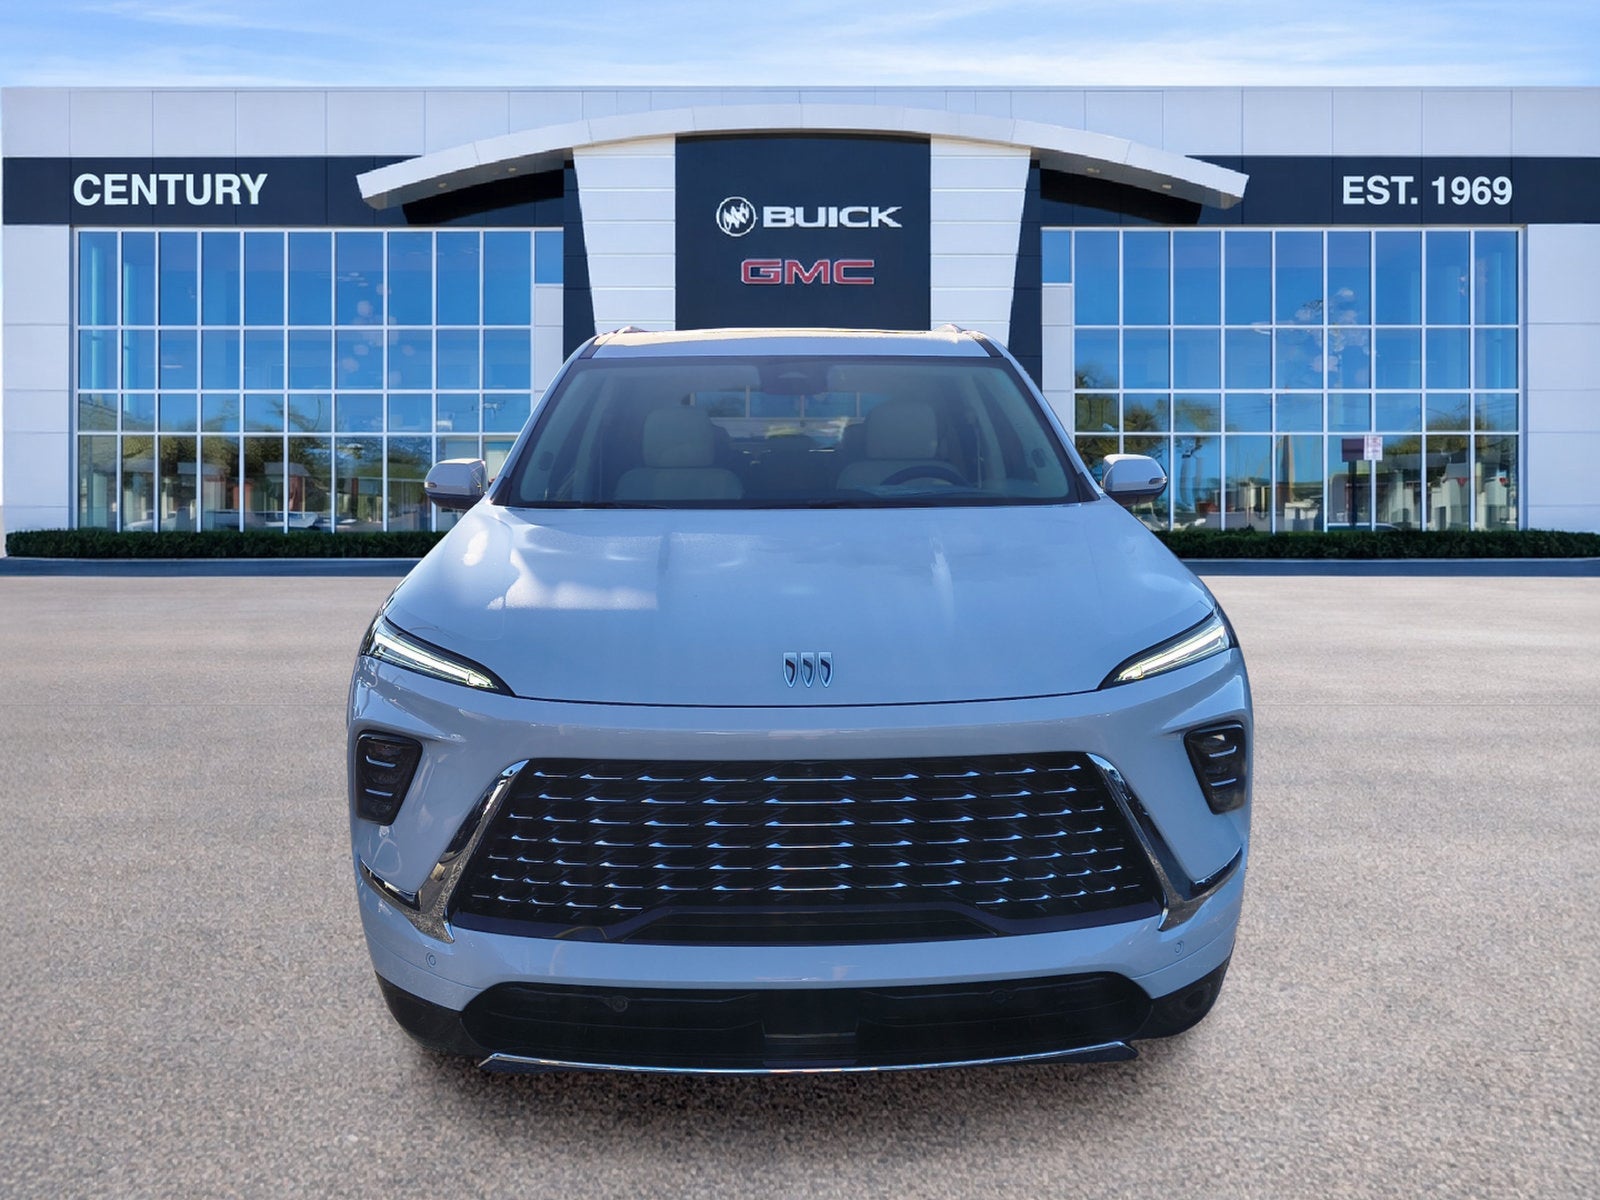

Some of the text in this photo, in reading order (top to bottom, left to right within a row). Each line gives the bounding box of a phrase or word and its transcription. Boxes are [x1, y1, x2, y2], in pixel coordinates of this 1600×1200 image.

[73, 173, 268, 206] CENTURY
[1343, 175, 1513, 206] EST. 1969
[762, 206, 903, 228] BUICK
[740, 258, 875, 285] GMC
